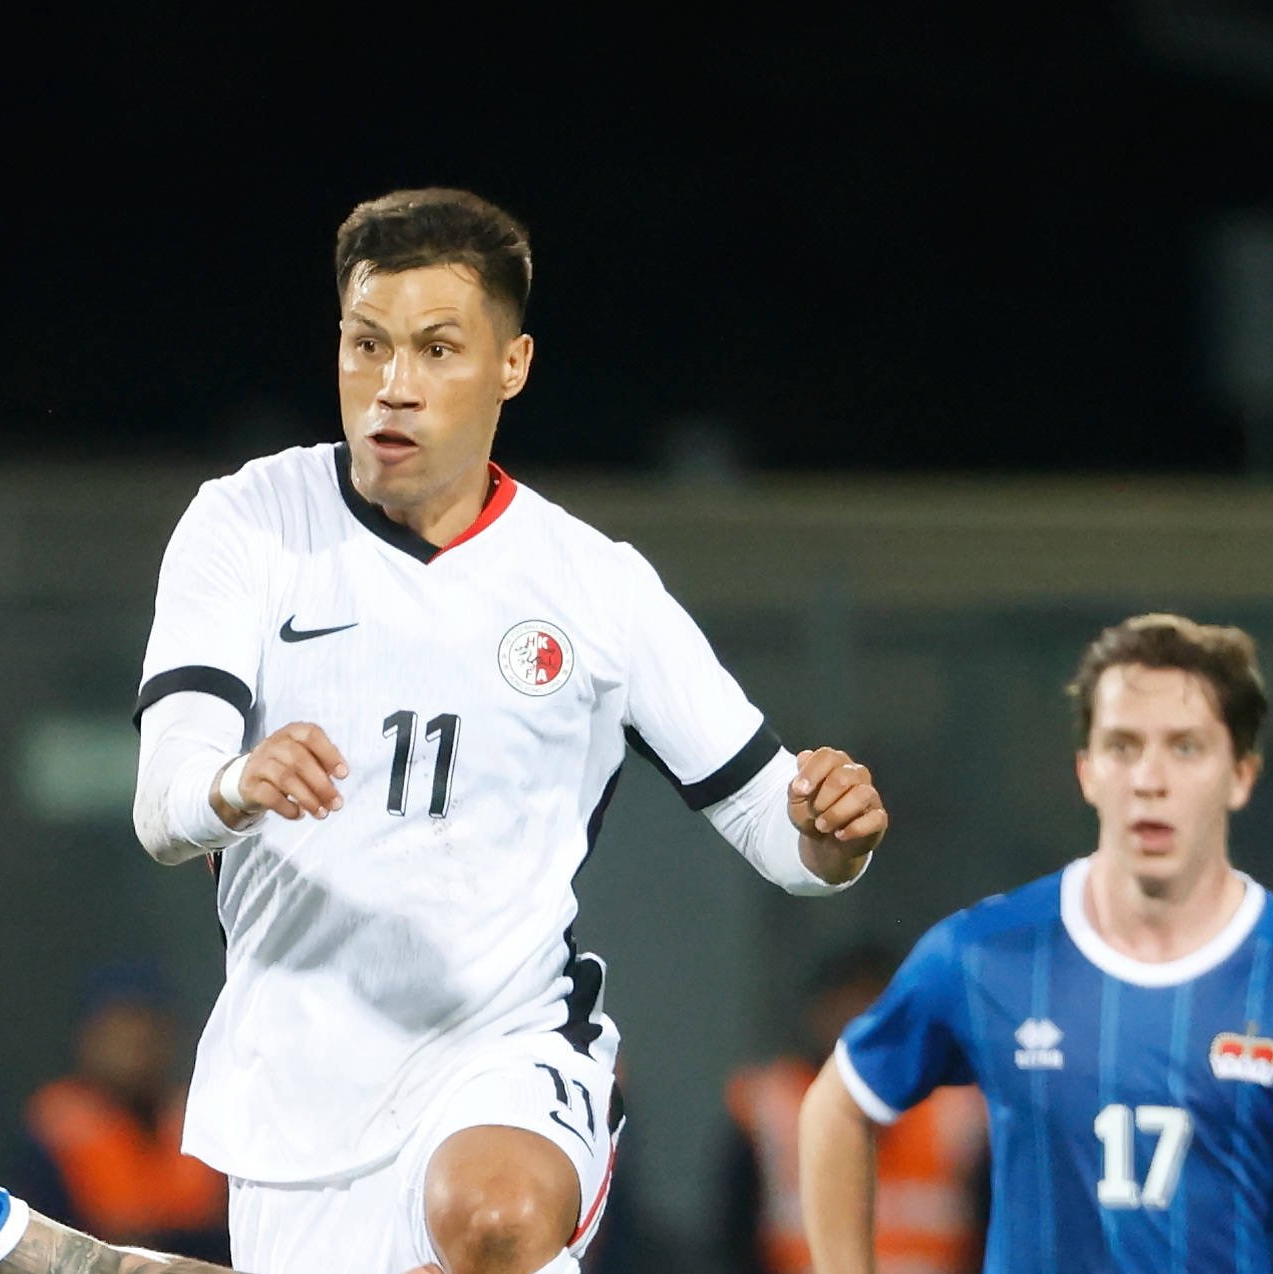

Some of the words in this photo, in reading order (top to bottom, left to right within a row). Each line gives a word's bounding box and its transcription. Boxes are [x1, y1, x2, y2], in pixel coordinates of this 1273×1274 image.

[382, 709, 462, 820] 11
[533, 1062, 596, 1142] 11
[1093, 1103, 1194, 1211] 17
